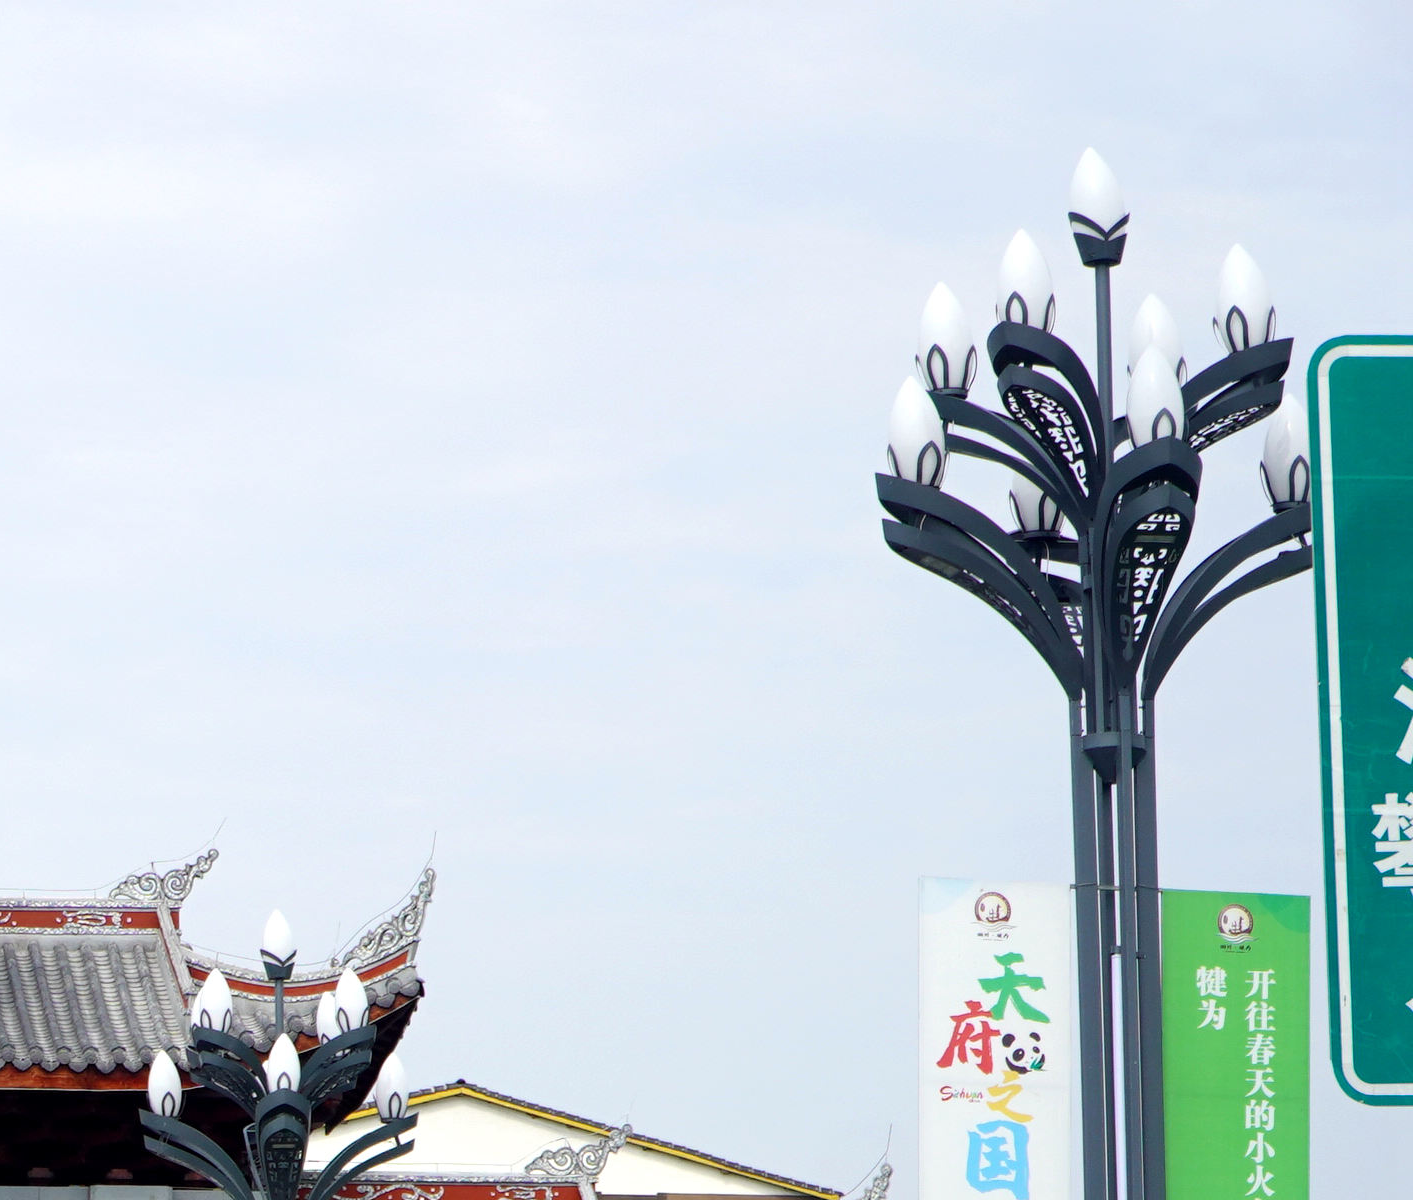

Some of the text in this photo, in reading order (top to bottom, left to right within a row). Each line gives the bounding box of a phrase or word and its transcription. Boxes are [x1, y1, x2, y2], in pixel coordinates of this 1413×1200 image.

[936, 952, 1050, 1200] 天府之国
[1196, 966, 1228, 1030] 犍为
